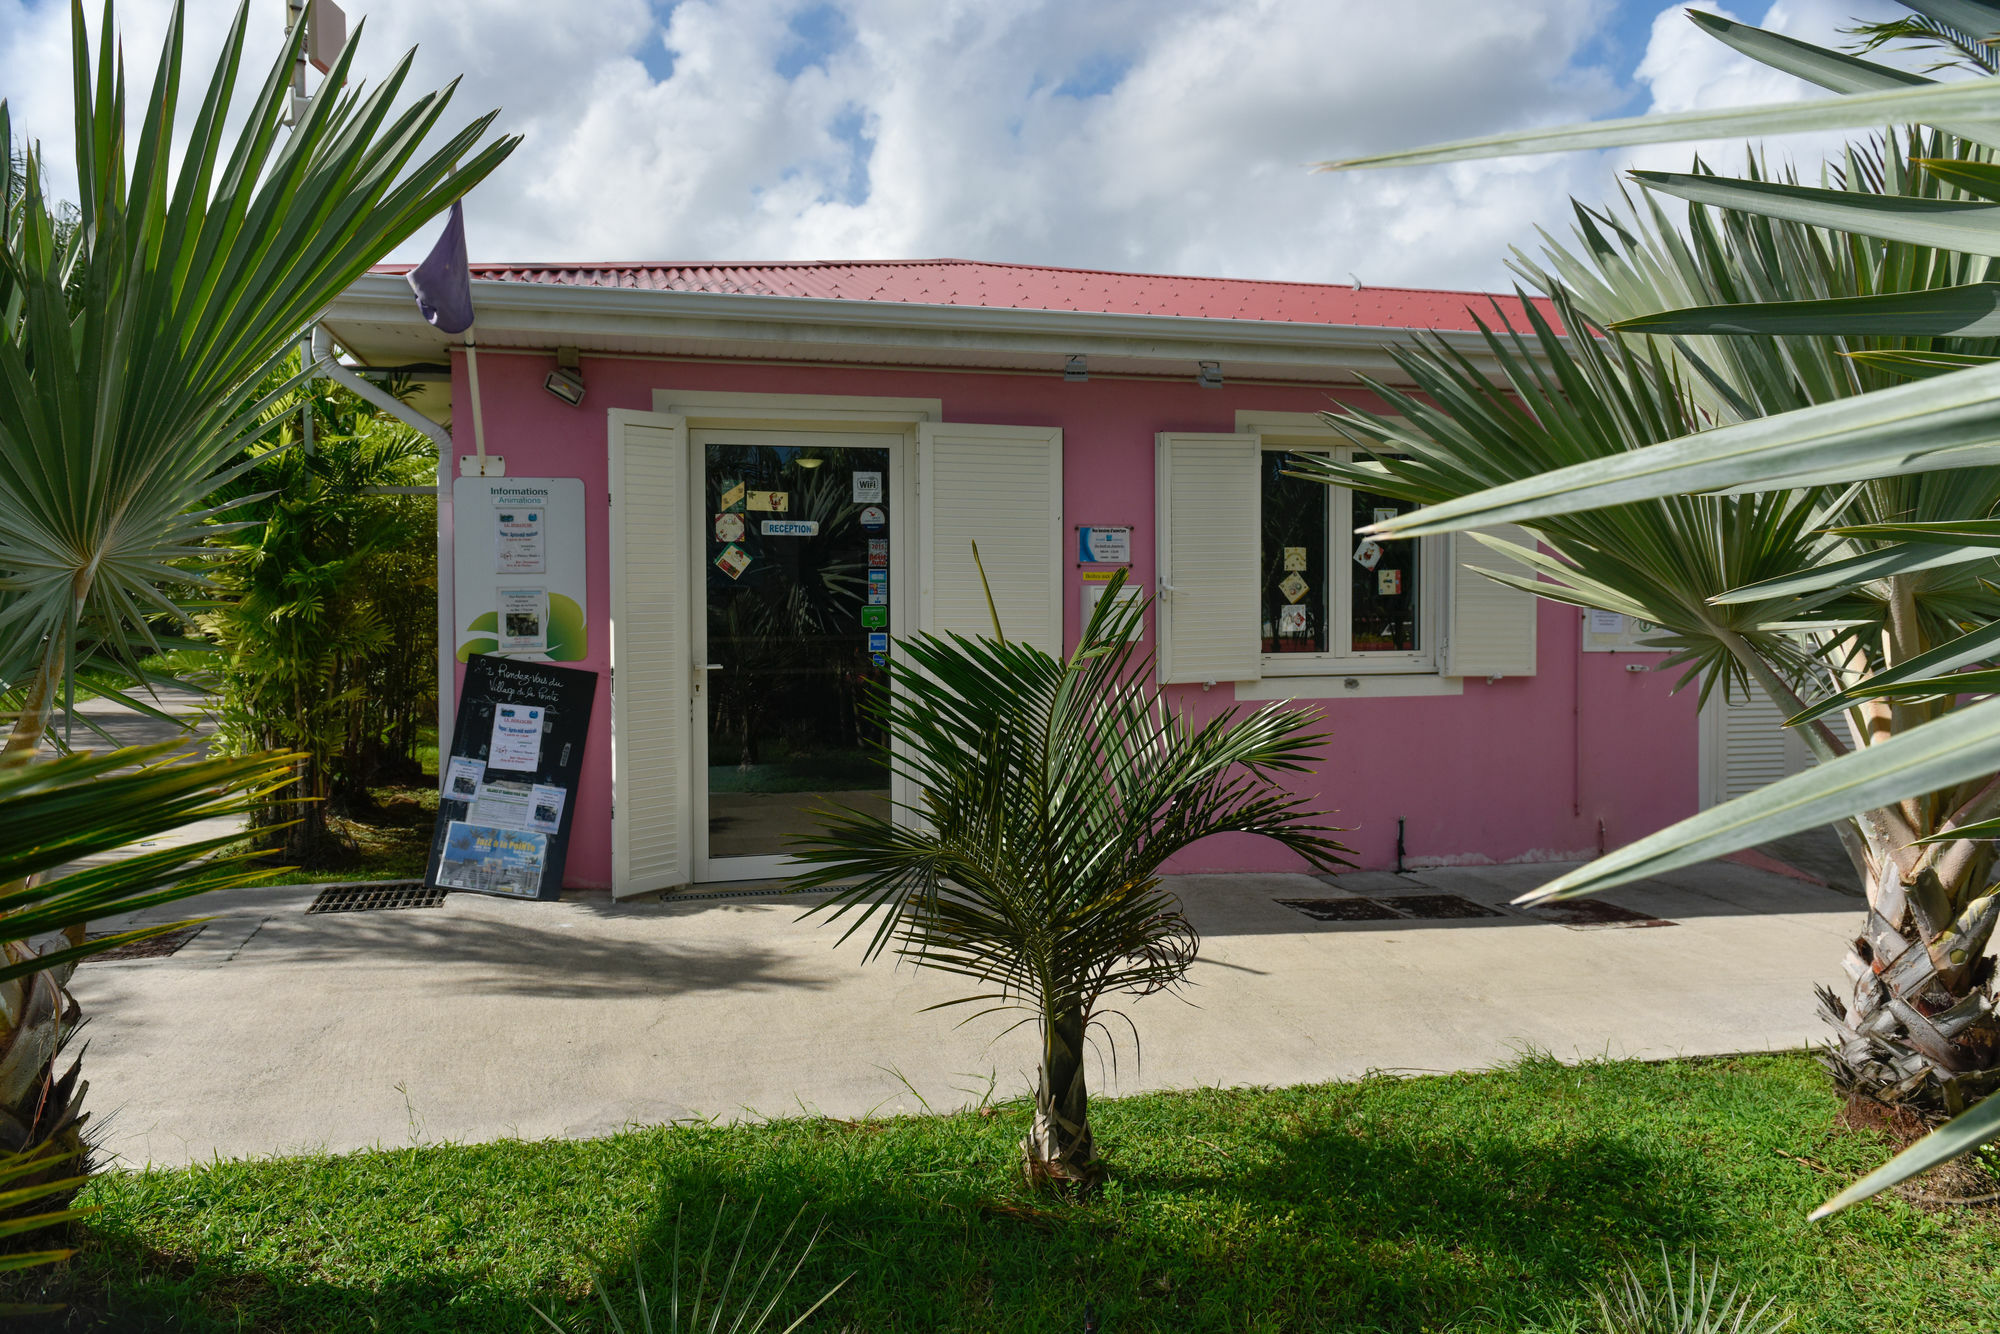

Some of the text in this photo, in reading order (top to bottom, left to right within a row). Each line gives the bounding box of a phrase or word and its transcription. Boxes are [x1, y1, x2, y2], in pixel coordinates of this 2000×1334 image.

[490, 487, 549, 496] Informations
[498, 496, 542, 504] Animations
[769, 524, 812, 533] RECEPTION
[538, 686, 560, 702] Pointe
